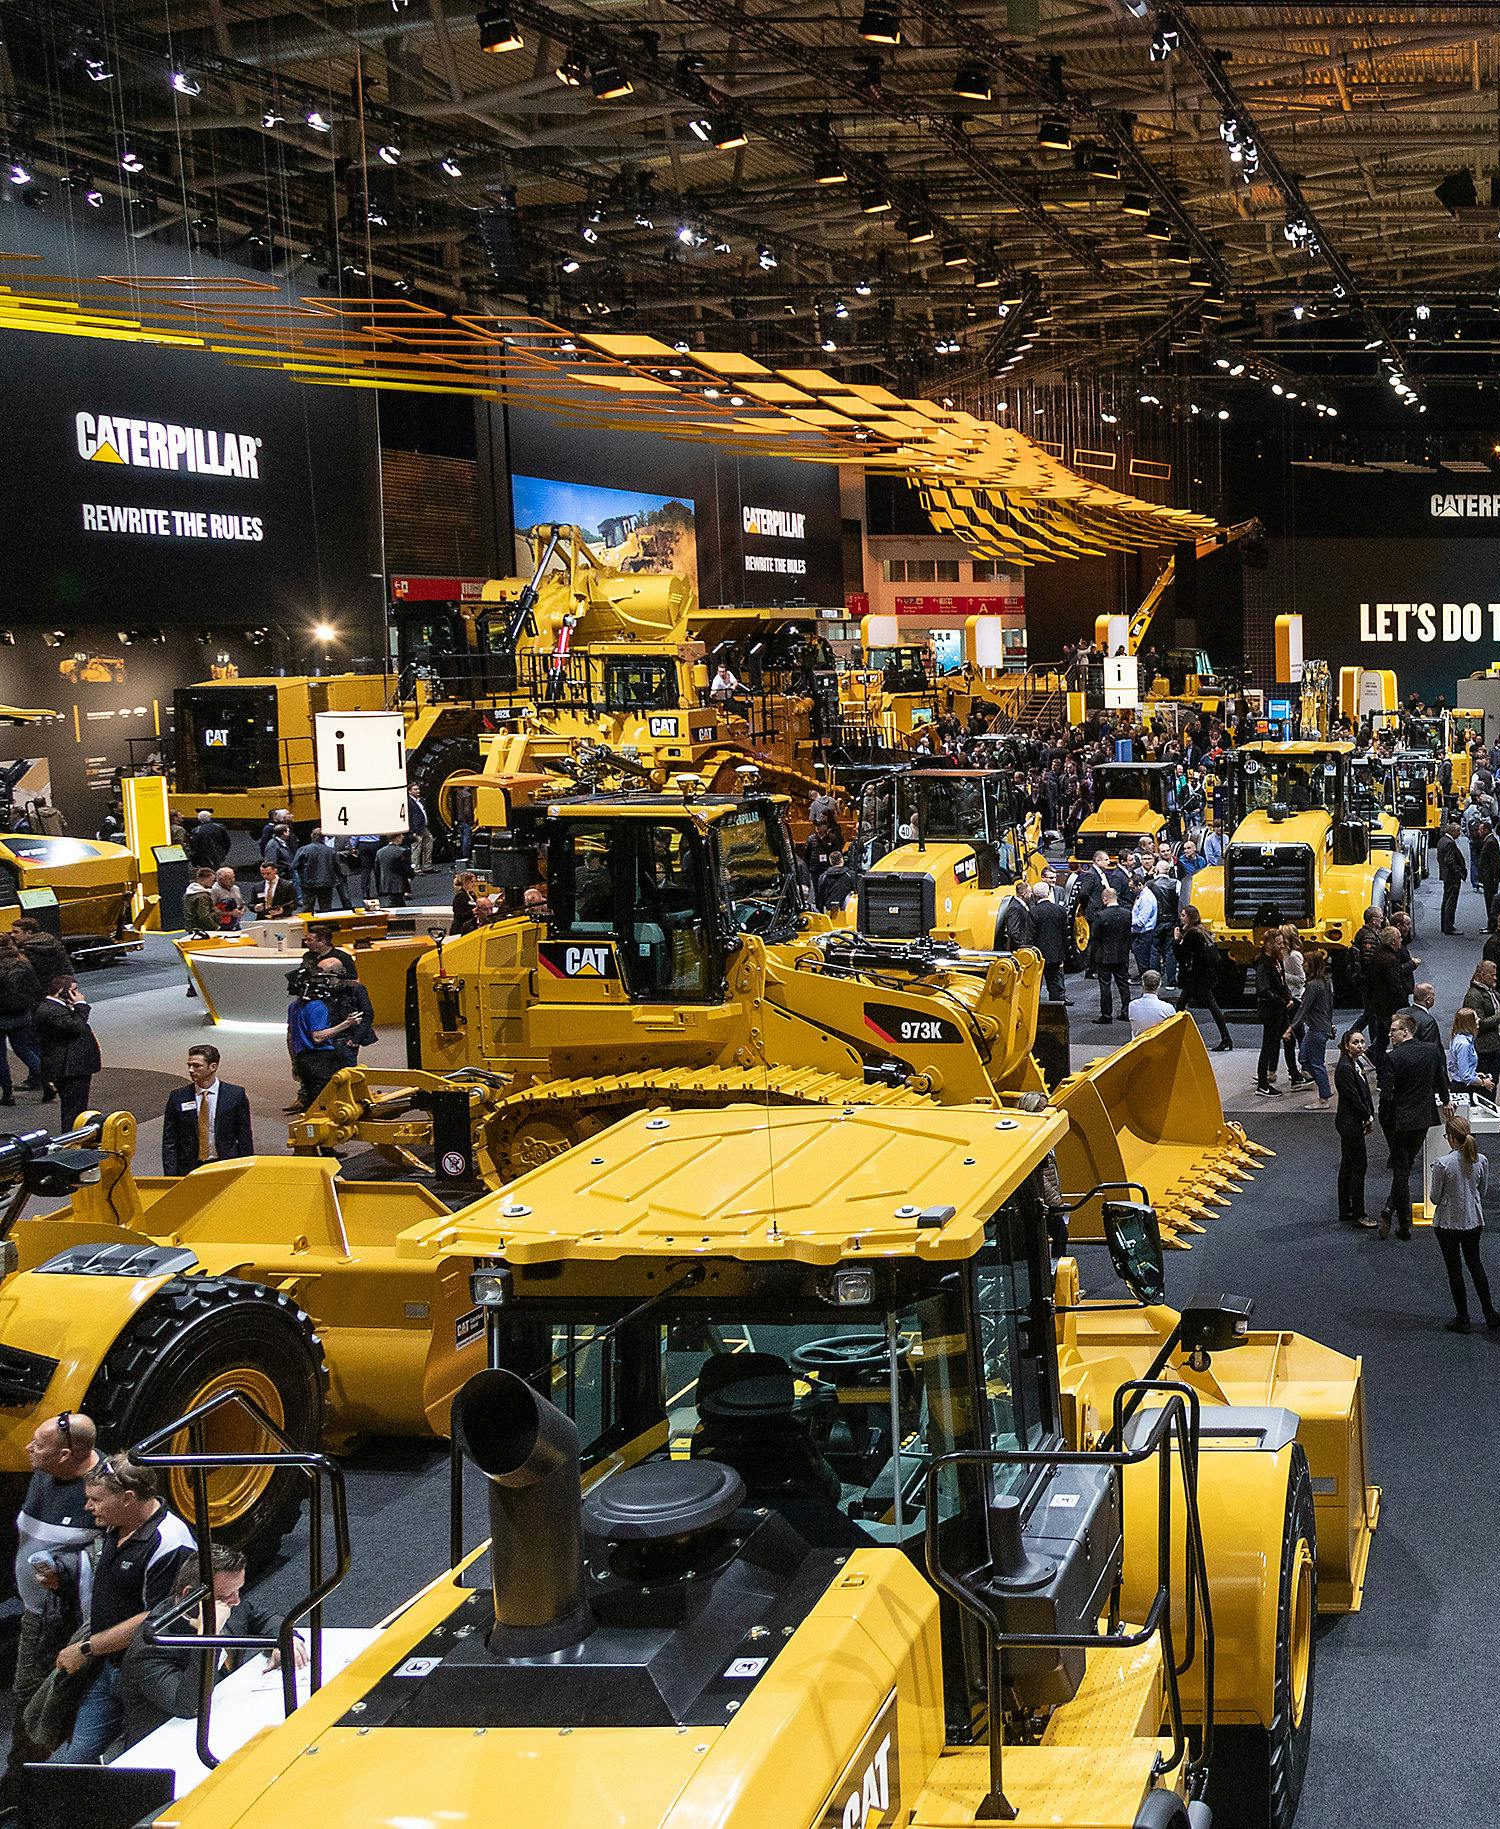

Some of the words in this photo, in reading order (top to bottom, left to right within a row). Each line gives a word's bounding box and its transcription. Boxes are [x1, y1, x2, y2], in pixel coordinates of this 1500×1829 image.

[82, 503, 171, 536] REWRITE
[171, 510, 209, 538] THE
[210, 513, 263, 542] RULES
[744, 555, 774, 573] REWRITE
[774, 557, 787, 574] THE
[787, 558, 806, 575] RULES
[1360, 602, 1436, 642] LET'S
[1442, 602, 1482, 642] DO
[1117, 696, 1122, 705] 1
[651, 718, 677, 737] CAT
[699, 726, 712, 741] CAT
[205, 729, 229, 747] CAT
[338, 806, 349, 826] 4
[901, 826, 911, 837] 40
[1260, 846, 1276, 857] CAT
[889, 906, 900, 914] CAT
[565, 947, 609, 976] CAT
[901, 1021, 942, 1039] 973K
[457, 1319, 470, 1337] CAT
[842, 1731, 891, 1829] CAT
